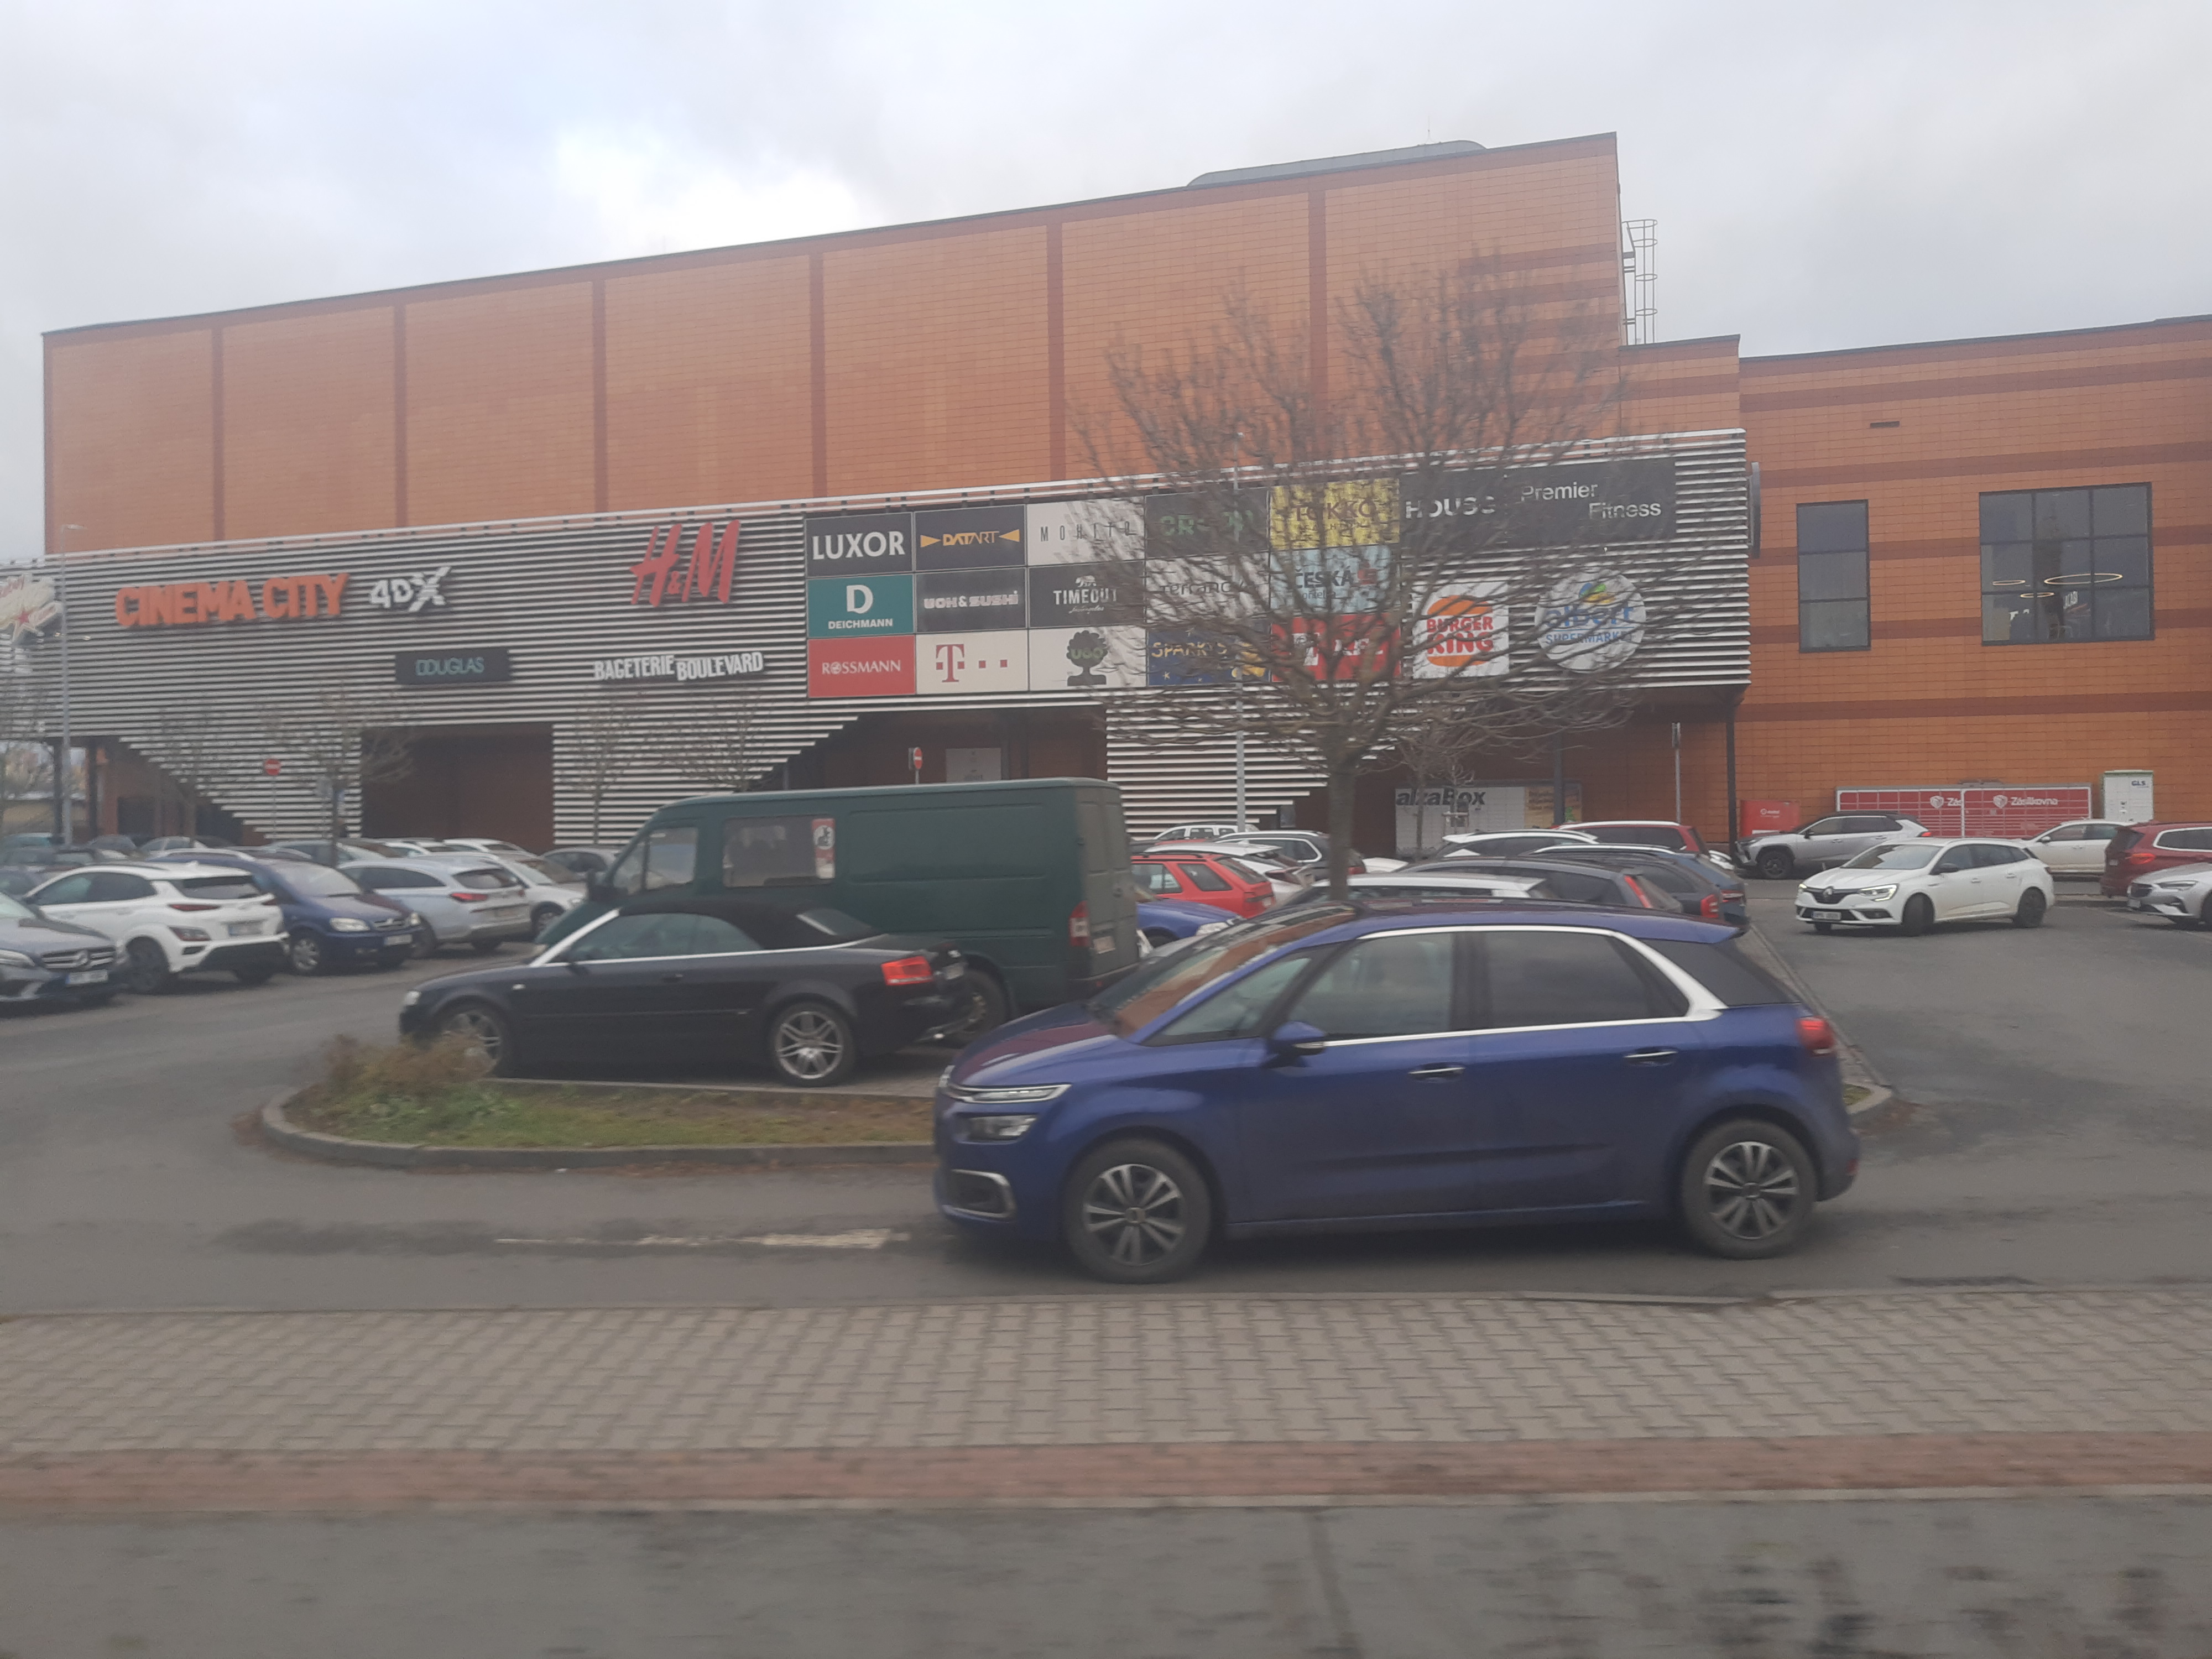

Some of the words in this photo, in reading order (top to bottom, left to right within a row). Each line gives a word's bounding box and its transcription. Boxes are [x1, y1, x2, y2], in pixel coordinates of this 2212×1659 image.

[1521, 481, 1598, 502] Premier
[1588, 502, 1661, 519] Fitness
[942, 531, 1000, 546] DATART
[1040, 521, 1130, 542] MOHITO
[812, 531, 905, 560] LUXOR
[628, 519, 740, 607] H&M
[369, 566, 451, 612] 4DX
[1053, 588, 1117, 604] TIMEOUT
[1160, 581, 1251, 596] errano
[115, 580, 257, 627] CINEMA
[262, 573, 351, 619] CITY
[846, 585, 873, 614] D
[958, 596, 967, 607] &
[828, 618, 893, 630] DEICHMANN
[1427, 617, 1493, 633] BURGER
[1427, 632, 1493, 654] KING
[1546, 631, 1632, 645] SUPERMARK
[416, 656, 484, 676] DOUGLAS
[593, 655, 675, 681] BAGETERIE
[676, 652, 764, 681] BOULEVARD
[822, 660, 901, 675] ROSSMANN
